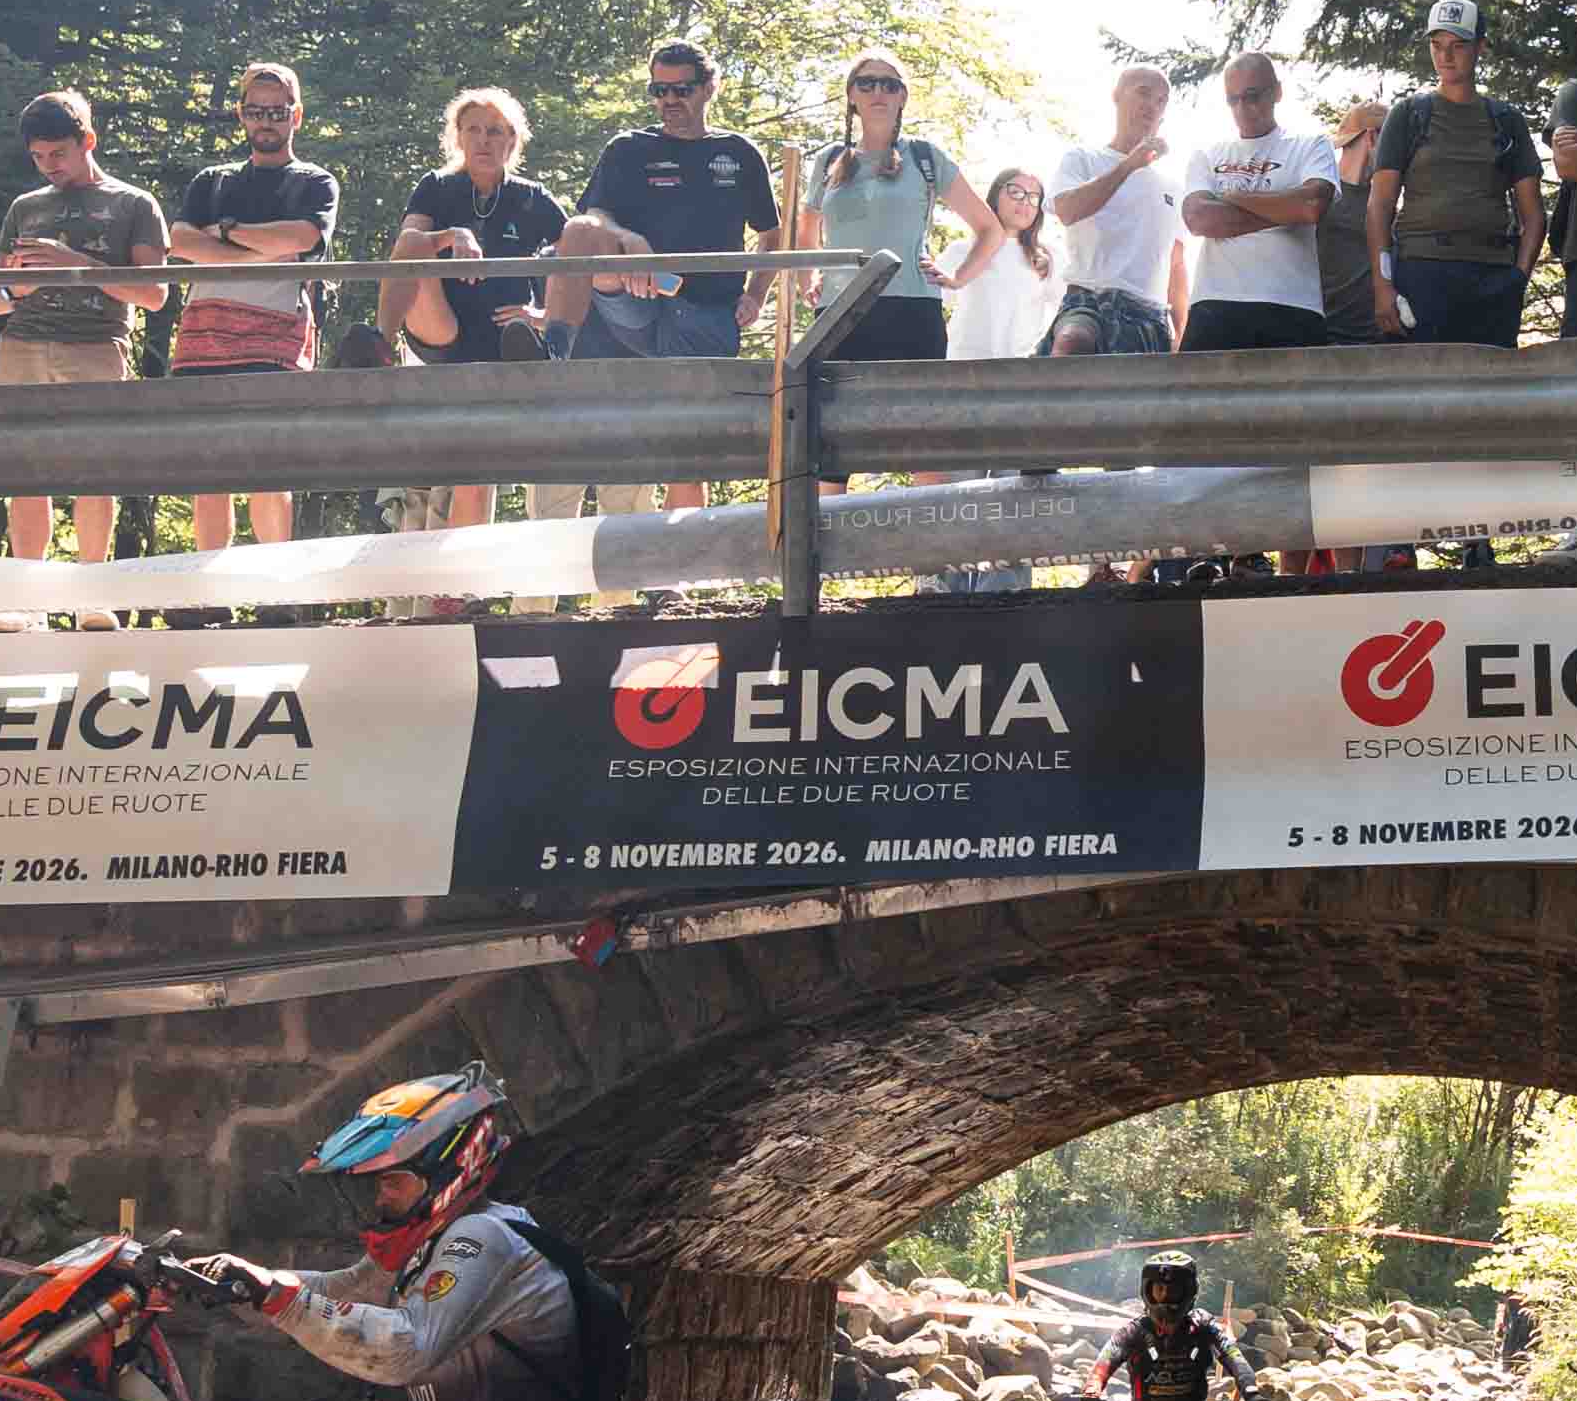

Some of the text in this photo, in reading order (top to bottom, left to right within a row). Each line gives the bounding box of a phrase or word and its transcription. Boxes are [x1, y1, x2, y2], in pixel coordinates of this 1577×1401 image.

[732, 662, 1071, 743] EICMA
[1344, 733, 1546, 760] ESPOSIZIONE
[57, 762, 310, 785] INTERNAZIONALE
[608, 749, 1072, 780] ESPOSIZIONE INTERNAZIONALE
[1443, 764, 1539, 786] DELLE
[46, 795, 104, 817] DUE
[111, 793, 208, 815] RUOTE
[701, 781, 972, 806] DELLE DUE RUOTE
[1287, 826, 1304, 848] 5
[1331, 825, 1349, 847] 8
[1358, 817, 1508, 846] NOVEMBRE
[540, 846, 558, 870] 5
[583, 845, 601, 869] 8
[609, 842, 758, 869] NOVEMBRE
[765, 841, 847, 865] 2026.
[864, 835, 1036, 863] MILANO-RHO
[1043, 832, 1119, 858] FIERA
[11, 858, 90, 883] 2026.
[106, 852, 269, 881] MILANO-RHO
[276, 850, 348, 878] FIERA
